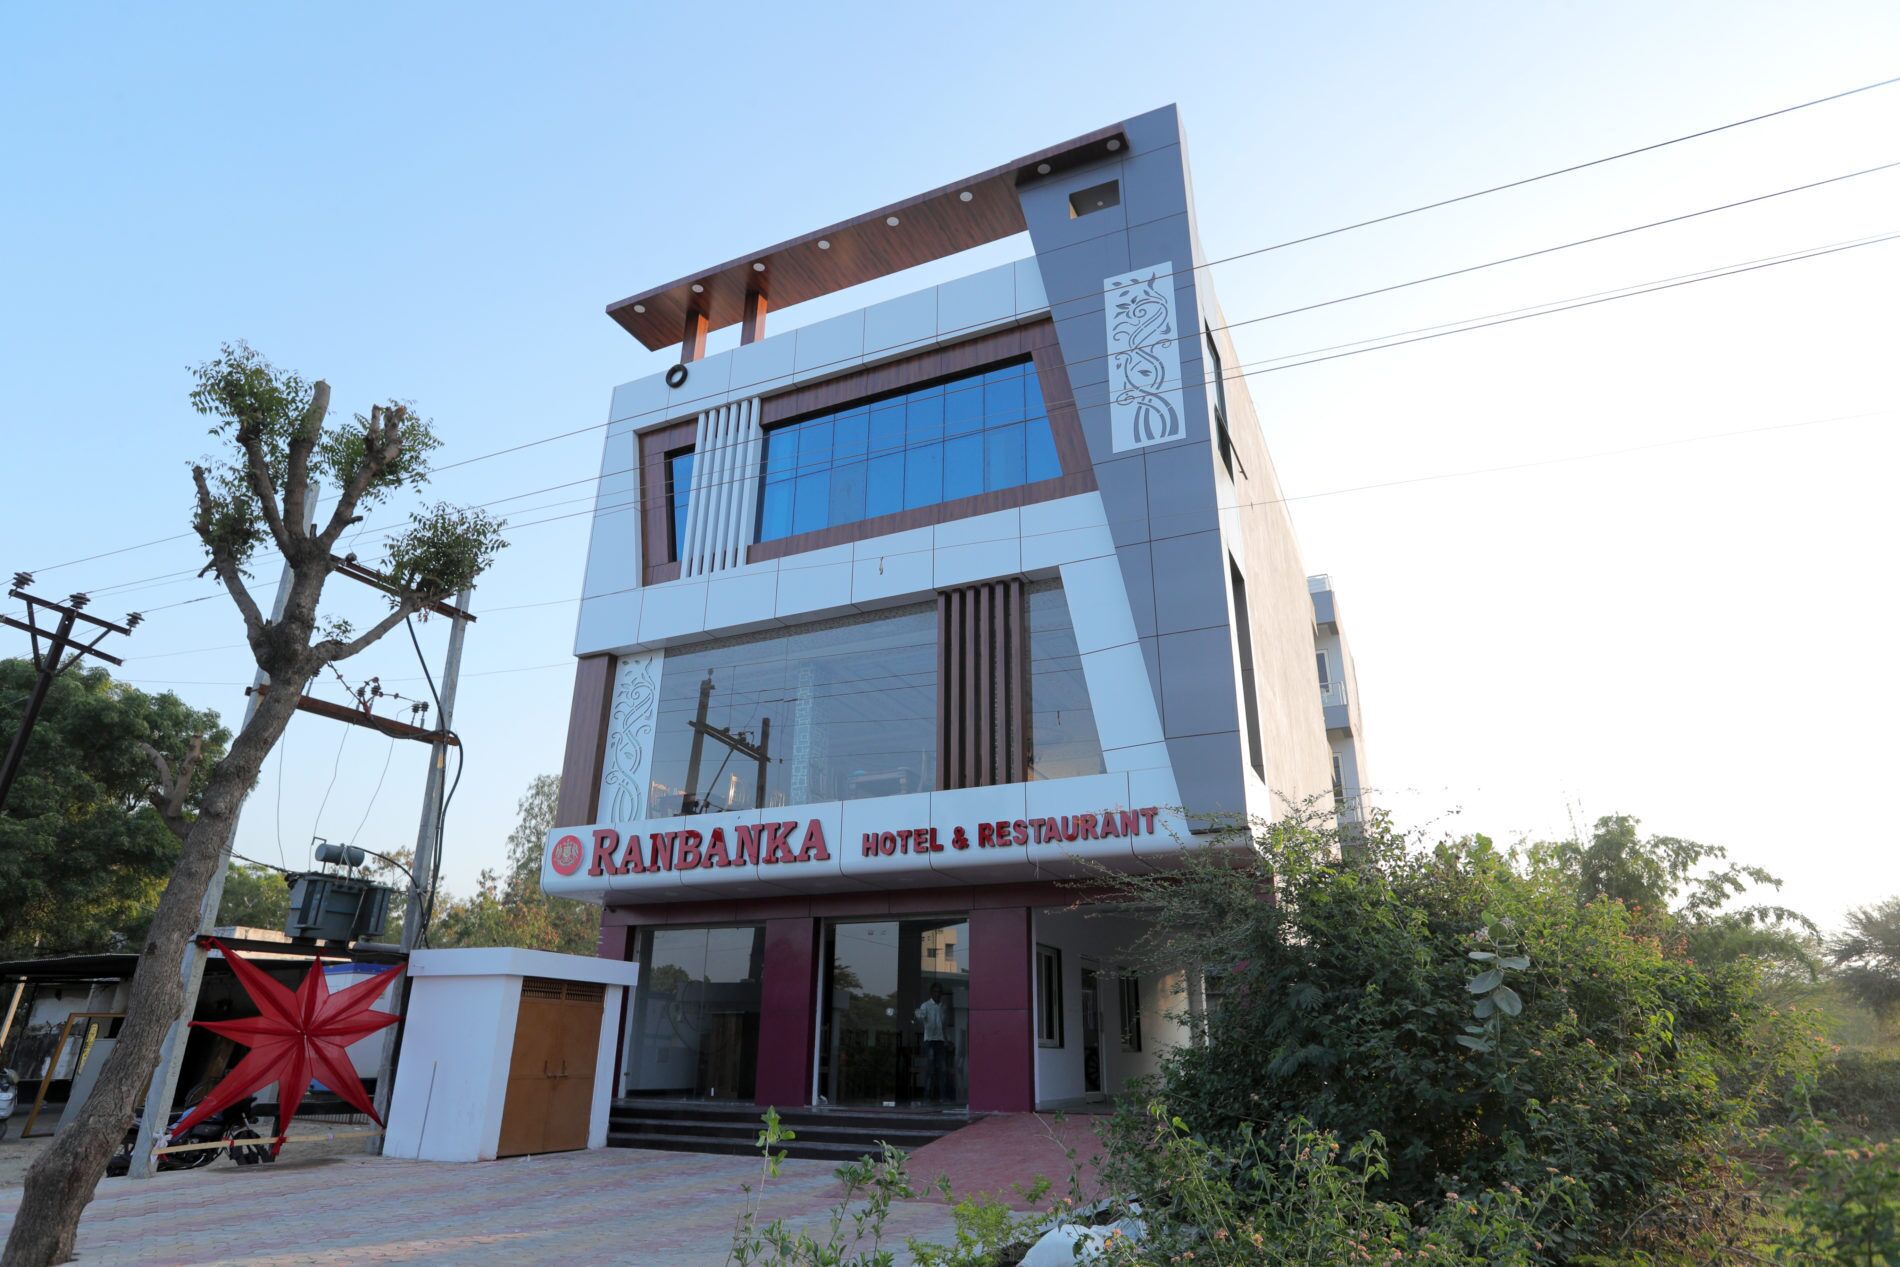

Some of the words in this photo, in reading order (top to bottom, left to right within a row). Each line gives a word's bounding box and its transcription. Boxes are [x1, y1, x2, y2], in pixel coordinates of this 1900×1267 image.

[588, 818, 831, 876] RANBANKA
[861, 827, 944, 857] HOTEL
[952, 825, 970, 850] &
[978, 807, 1159, 848] RESTAURANT
